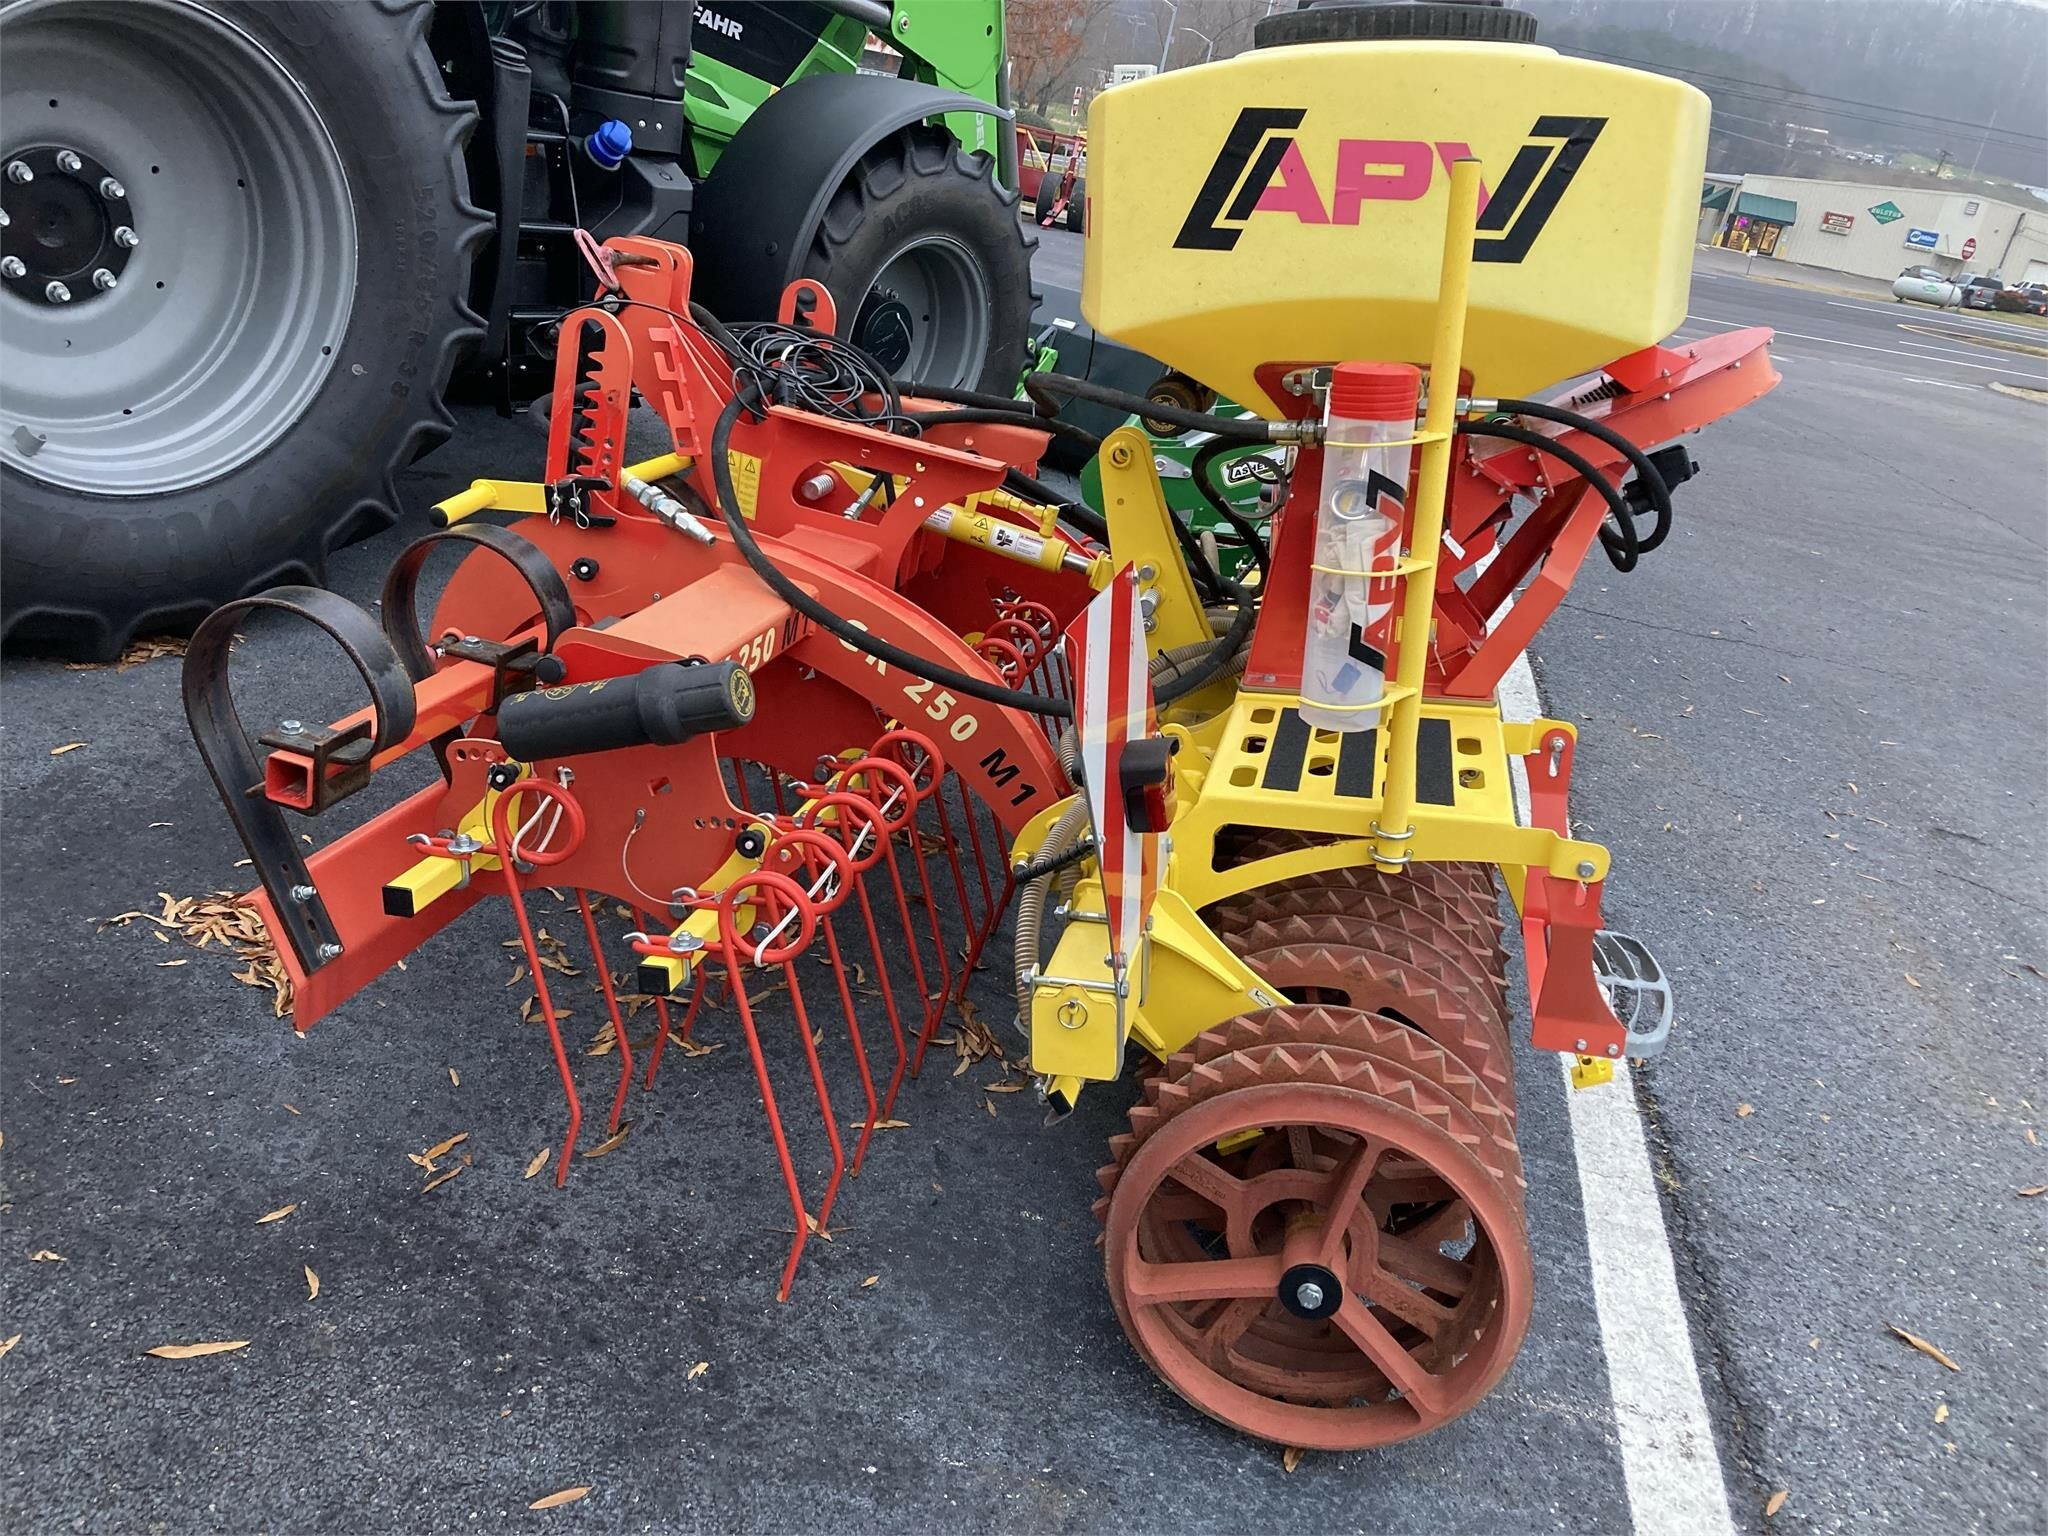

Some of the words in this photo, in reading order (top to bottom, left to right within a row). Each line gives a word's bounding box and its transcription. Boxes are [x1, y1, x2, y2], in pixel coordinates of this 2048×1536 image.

[738, 627, 776, 673] 250
[903, 676, 978, 742] 250
[979, 747, 1038, 807] M1
